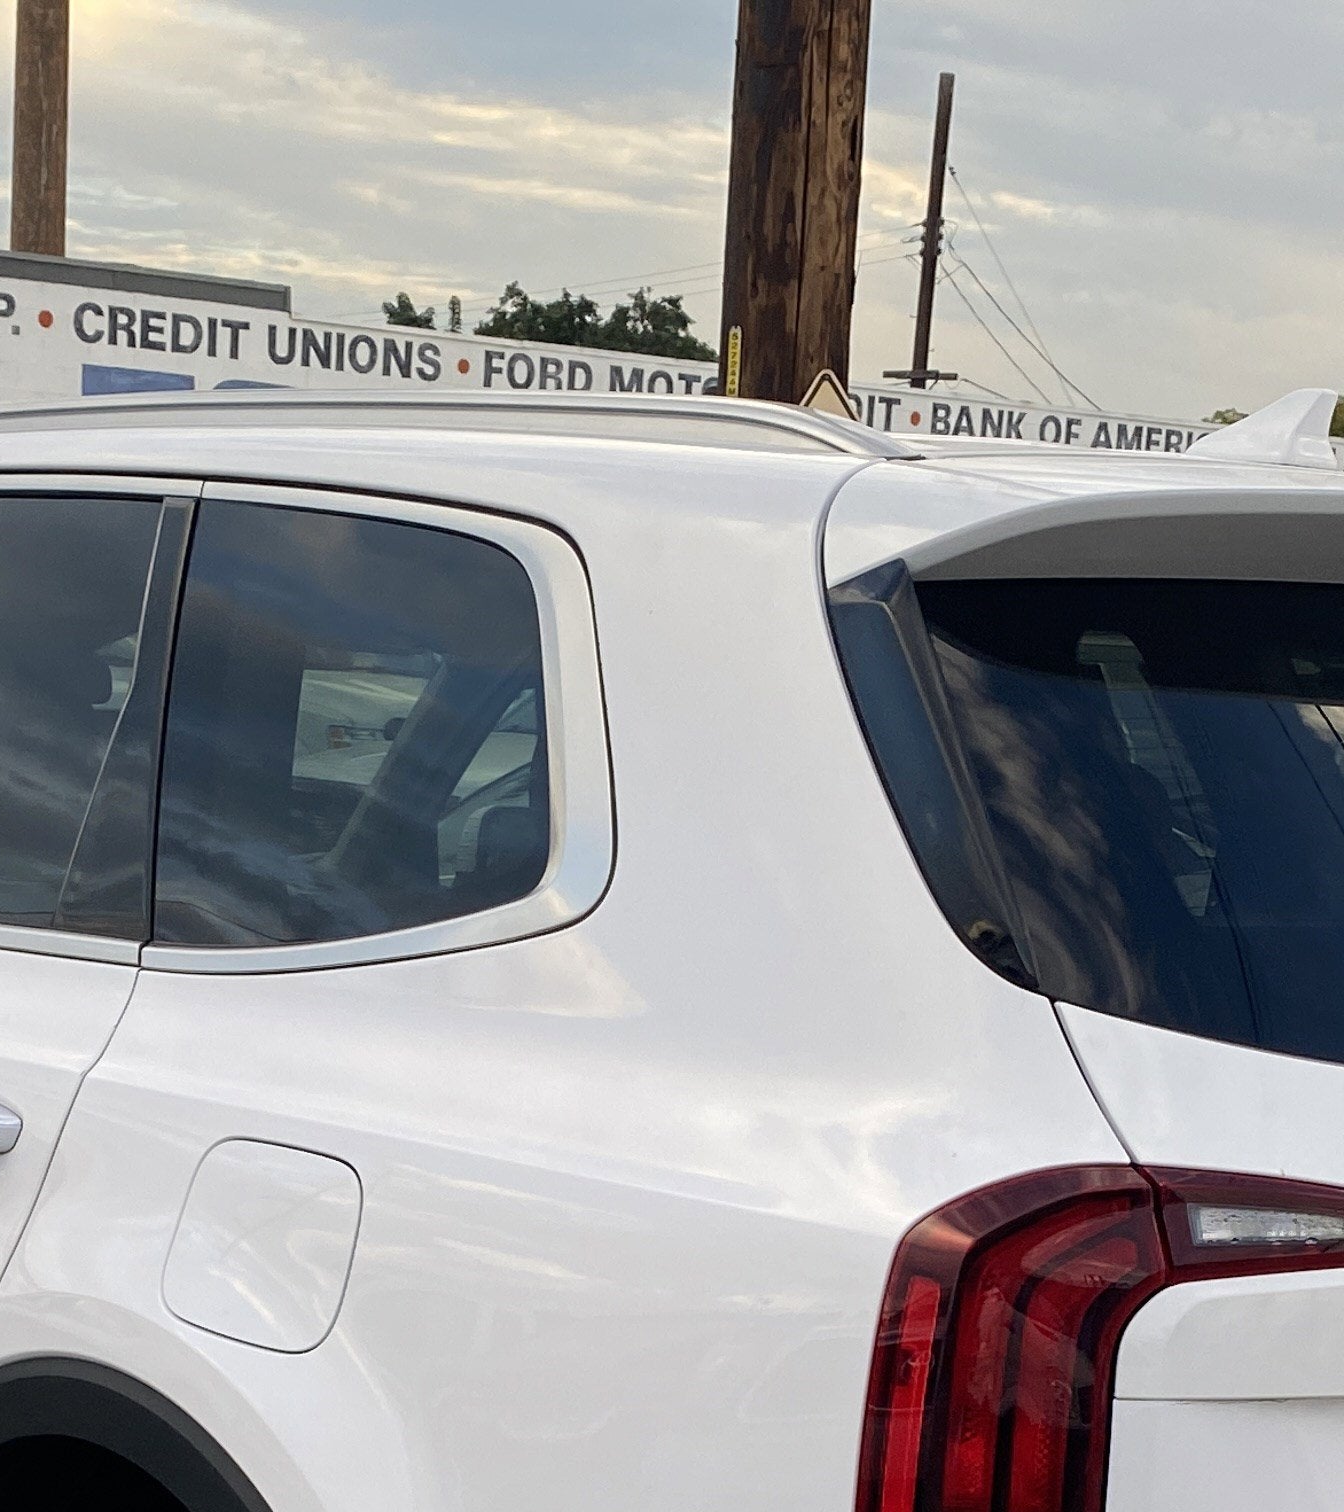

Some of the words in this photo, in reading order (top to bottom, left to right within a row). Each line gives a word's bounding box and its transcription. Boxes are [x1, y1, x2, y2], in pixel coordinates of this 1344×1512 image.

[73, 301, 250, 359] CREDIT
[267, 323, 441, 382] UNIONS
[483, 350, 593, 391] FORD
[609, 365, 718, 395] MOT
[930, 402, 1027, 440] BANK
[1039, 414, 1082, 444] OF
